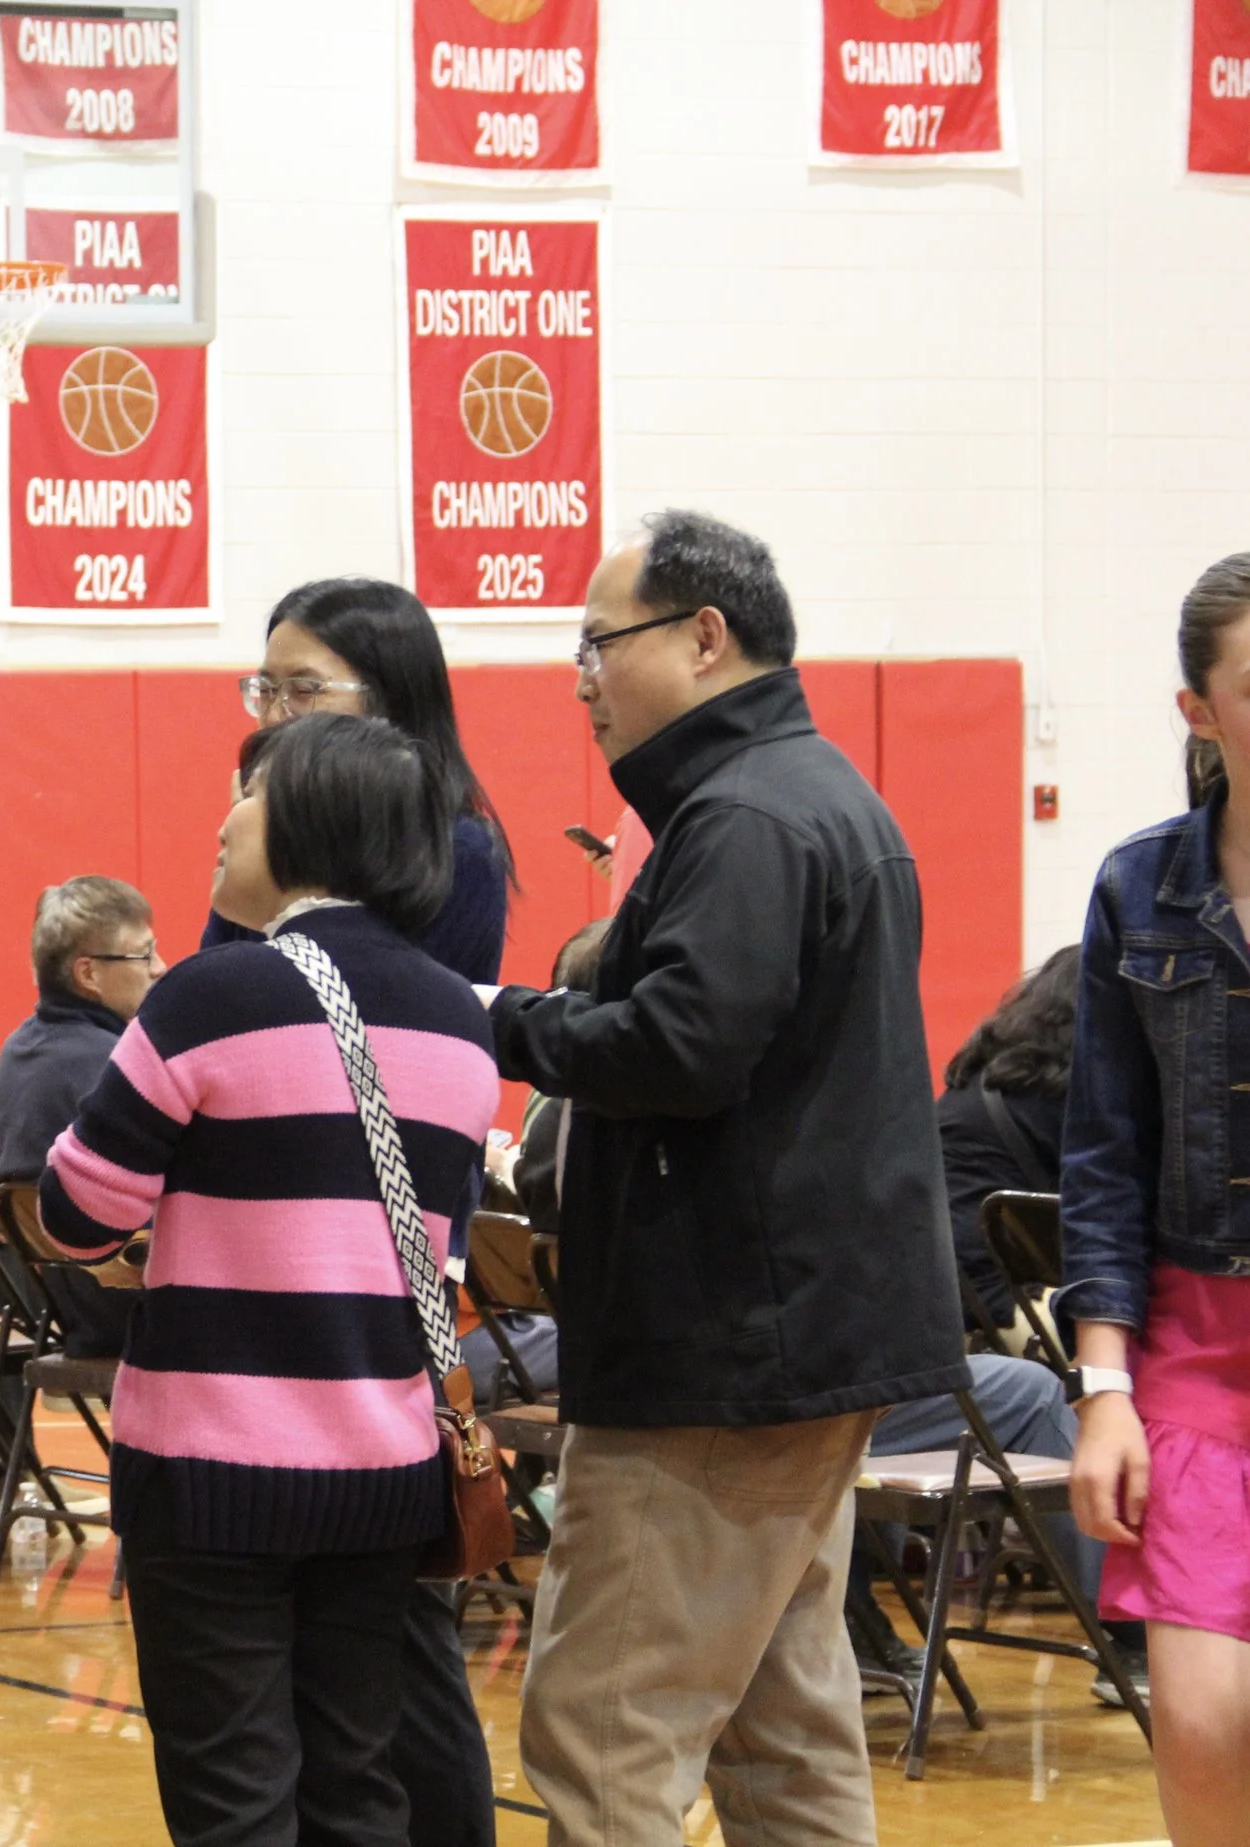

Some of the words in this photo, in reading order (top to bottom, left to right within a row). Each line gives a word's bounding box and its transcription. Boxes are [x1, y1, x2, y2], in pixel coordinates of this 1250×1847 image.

[18, 17, 178, 68] CHAMPIONS
[841, 39, 983, 86] CHAMPIONS
[431, 41, 585, 94] CHAMPIONS
[65, 87, 135, 133] 2008
[884, 104, 945, 148] 2017
[474, 111, 540, 158] 2009
[74, 219, 142, 268] PIAA
[472, 229, 533, 276] PIAA
[416, 289, 532, 337] DISTRICT
[537, 290, 593, 338] ONE
[26, 477, 193, 528] CHAMPIONS
[432, 480, 588, 528] CHAMPIONS
[74, 554, 147, 602] 2024
[477, 553, 545, 601] 2025
